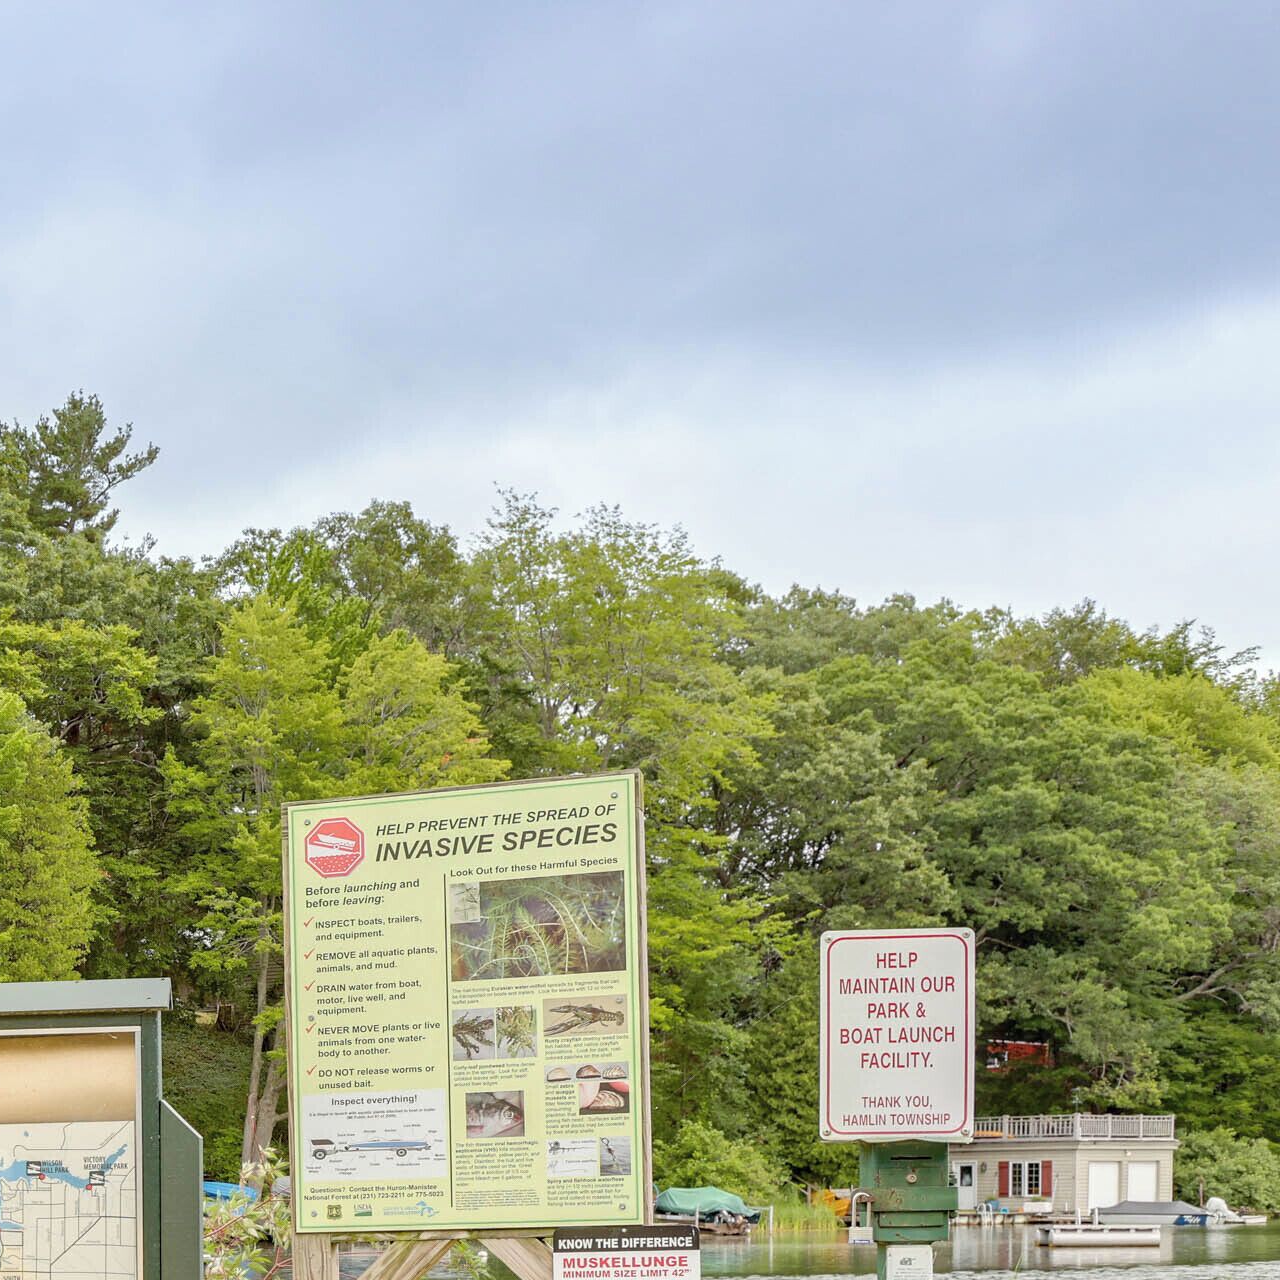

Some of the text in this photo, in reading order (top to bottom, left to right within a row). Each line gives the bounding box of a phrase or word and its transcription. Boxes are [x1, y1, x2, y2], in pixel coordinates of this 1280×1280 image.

[376, 803, 617, 837] HELP PREVENT THE SPREAD OF
[375, 822, 618, 862] INVASIVE SPECIES
[450, 857, 618, 878] Look Out for these Harmful Species
[305, 879, 420, 896] Before launching and
[305, 894, 385, 909] before leaving:
[315, 914, 423, 929] INSPECT boats, trailers,
[315, 930, 385, 941] and equipment.
[316, 946, 438, 961] REMOVE all aquatic plants,
[316, 961, 398, 973] animals, and mud.
[876, 952, 918, 969] HELP
[317, 980, 422, 993] DRAIN water from boat,
[839, 976, 956, 995] MAINTAIN OUR
[317, 992, 406, 1005] motor, live well, and
[317, 1005, 367, 1016] equipment.
[867, 1002, 927, 1019] PARK &
[317, 1026, 350, 1035] NEVER
[352, 1024, 380, 1033] MOVE
[382, 1022, 410, 1033] plants
[424, 1021, 441, 1029] live
[317, 1038, 353, 1047] animals
[355, 1036, 376, 1045] from
[397, 1034, 426, 1042] water-
[840, 1026, 956, 1045] BOAT LAUNCH
[318, 1047, 391, 1059] body to another.
[861, 1052, 934, 1069] FACILITY.
[318, 1069, 332, 1078] DO
[335, 1068, 354, 1077] NOT
[357, 1066, 389, 1076] release
[391, 1066, 423, 1074] worms
[318, 1079, 374, 1089] unused bait.
[331, 1094, 418, 1106] Inspect everything!
[861, 1095, 933, 1109] THANK YOU,
[842, 1113, 951, 1127] HAMLIN TOWNSHIP
[41, 1159, 63, 1167] WILSON
[83, 1163, 112, 1171] MEMORIAL
[54, 1166, 69, 1174] PARK
[310, 1186, 346, 1194] Questions?
[558, 1236, 693, 1250] KNOW THE DIFFERENCE
[563, 1256, 688, 1269] MUSKELLUNGE
[563, 1270, 611, 1279] MINIMUM
[614, 1270, 637, 1278] SIZE
[640, 1269, 669, 1278] LIMIT
